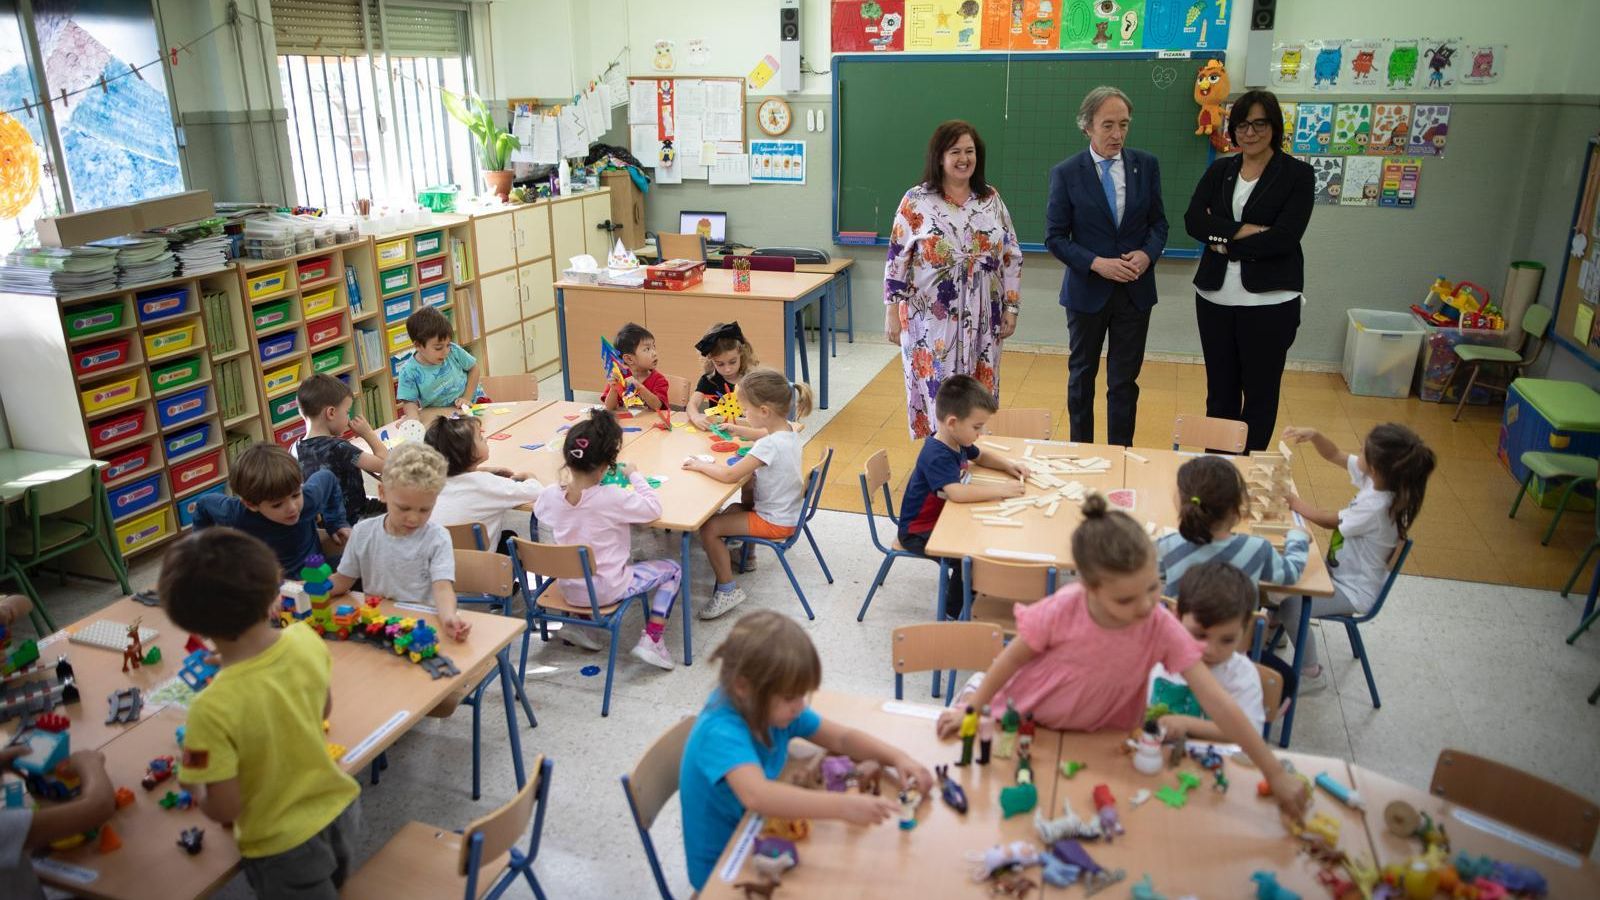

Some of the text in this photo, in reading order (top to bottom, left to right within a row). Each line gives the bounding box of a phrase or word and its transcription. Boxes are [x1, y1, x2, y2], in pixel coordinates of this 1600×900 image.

[911, 4, 933, 46] E
[987, 1, 1001, 45] I
[1067, 1, 1091, 41] O
[1149, 1, 1178, 43] U
[1216, 0, 1227, 19] 1
